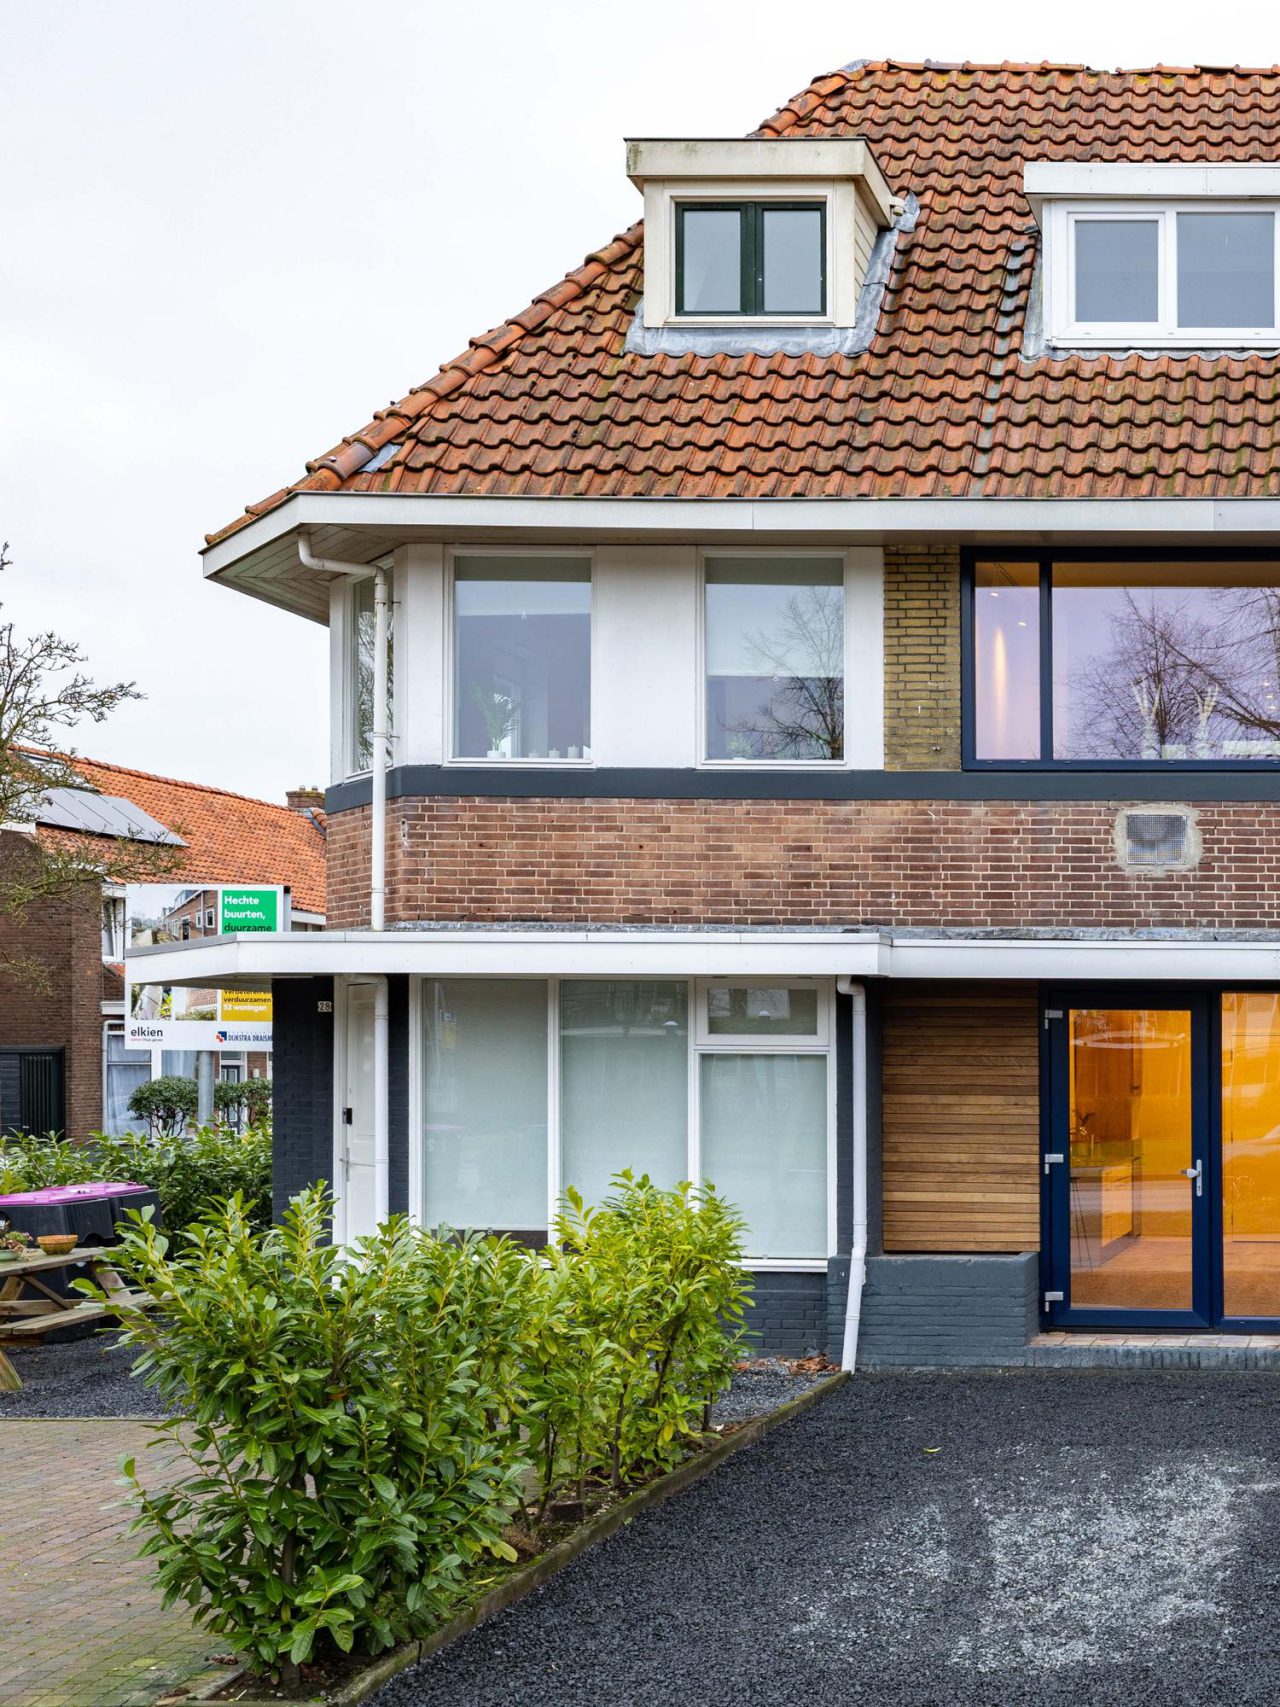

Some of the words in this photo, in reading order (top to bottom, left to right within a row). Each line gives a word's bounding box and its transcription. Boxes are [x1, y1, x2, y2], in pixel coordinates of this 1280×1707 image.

[224, 895, 260, 905] Hechte
[224, 909, 266, 921] buurten,
[224, 922, 272, 932] duurzame
[234, 1003, 267, 1012] woningen
[130, 1026, 163, 1037] elkien
